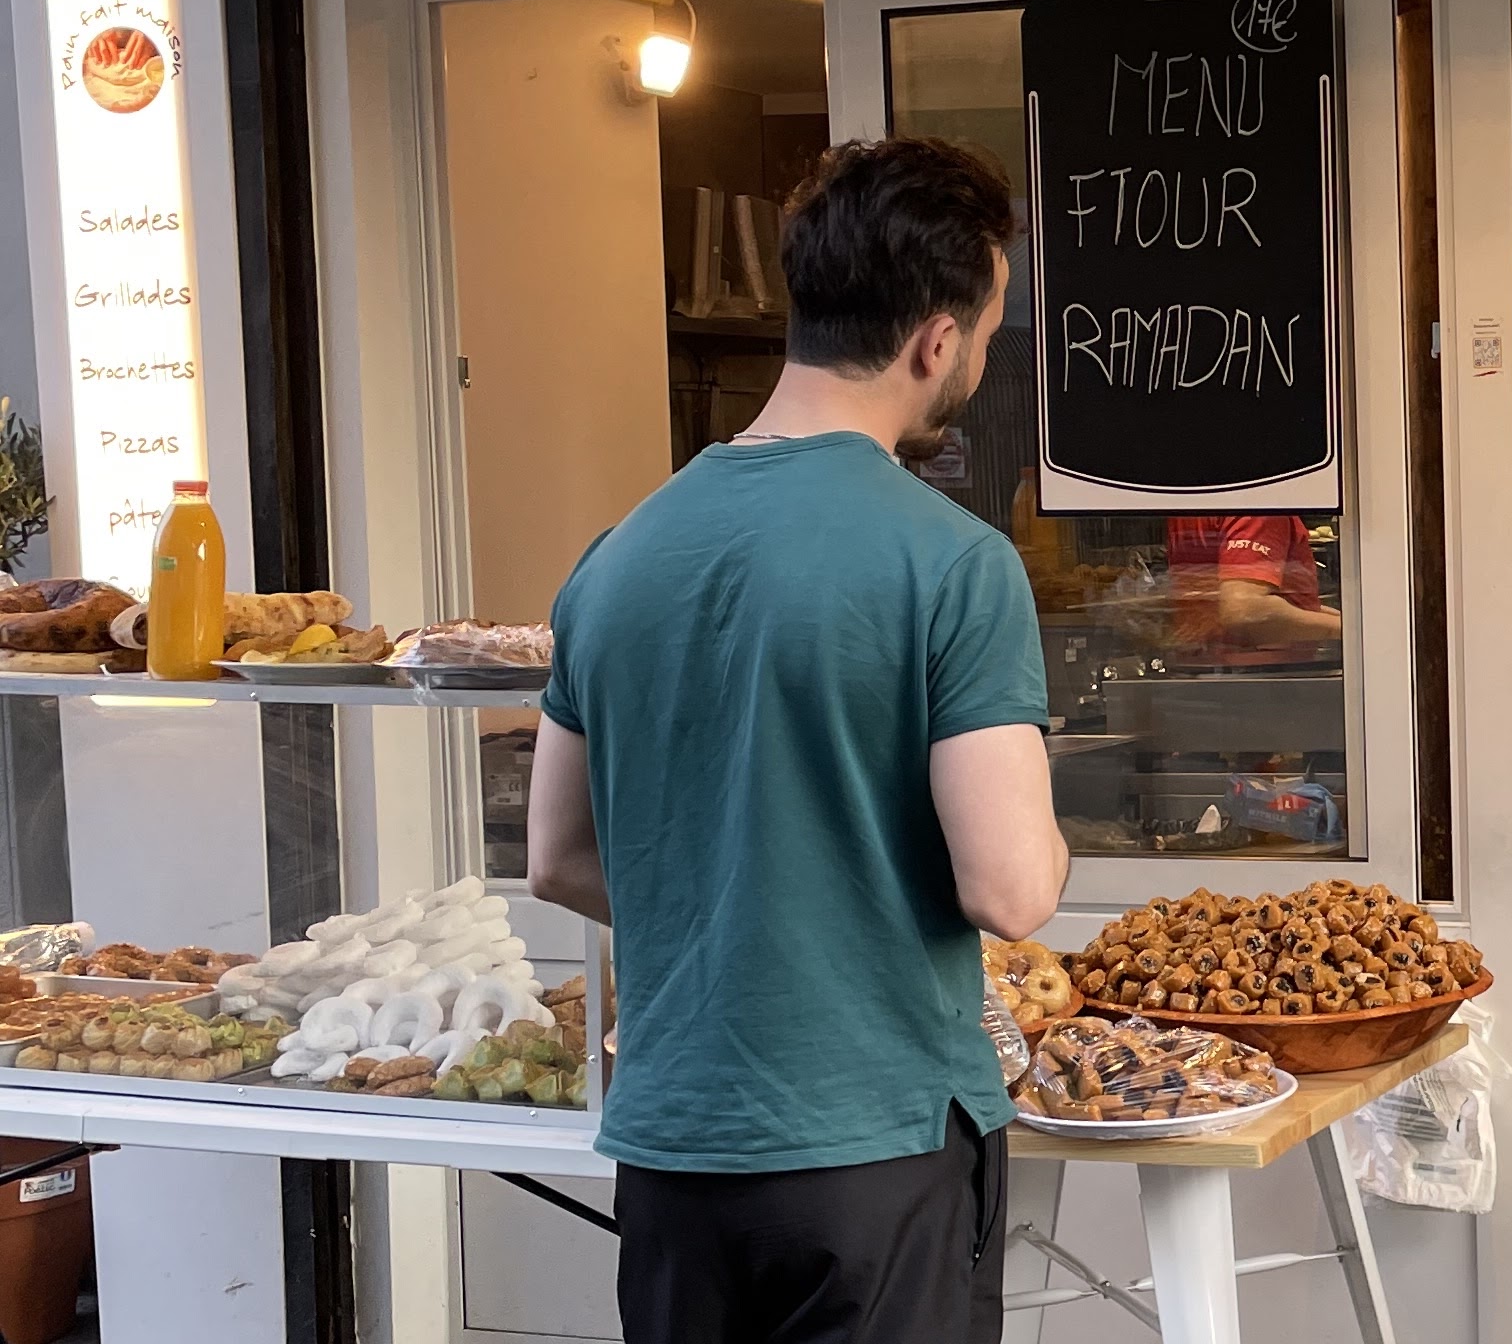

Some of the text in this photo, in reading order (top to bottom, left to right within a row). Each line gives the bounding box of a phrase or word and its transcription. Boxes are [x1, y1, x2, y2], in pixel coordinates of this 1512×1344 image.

[136, 6, 182, 80] maison
[1108, 50, 1264, 138] MENU
[79, 204, 180, 236] Salades
[1066, 167, 1261, 249] FTOUR
[75, 278, 192, 310] Grillades
[80, 352, 195, 383] Brochettes
[1062, 303, 1300, 398] RAMADAN
[101, 430, 180, 455] Pizzas
[109, 498, 163, 536] pâte
[1227, 539, 1271, 556] JUST EAT
